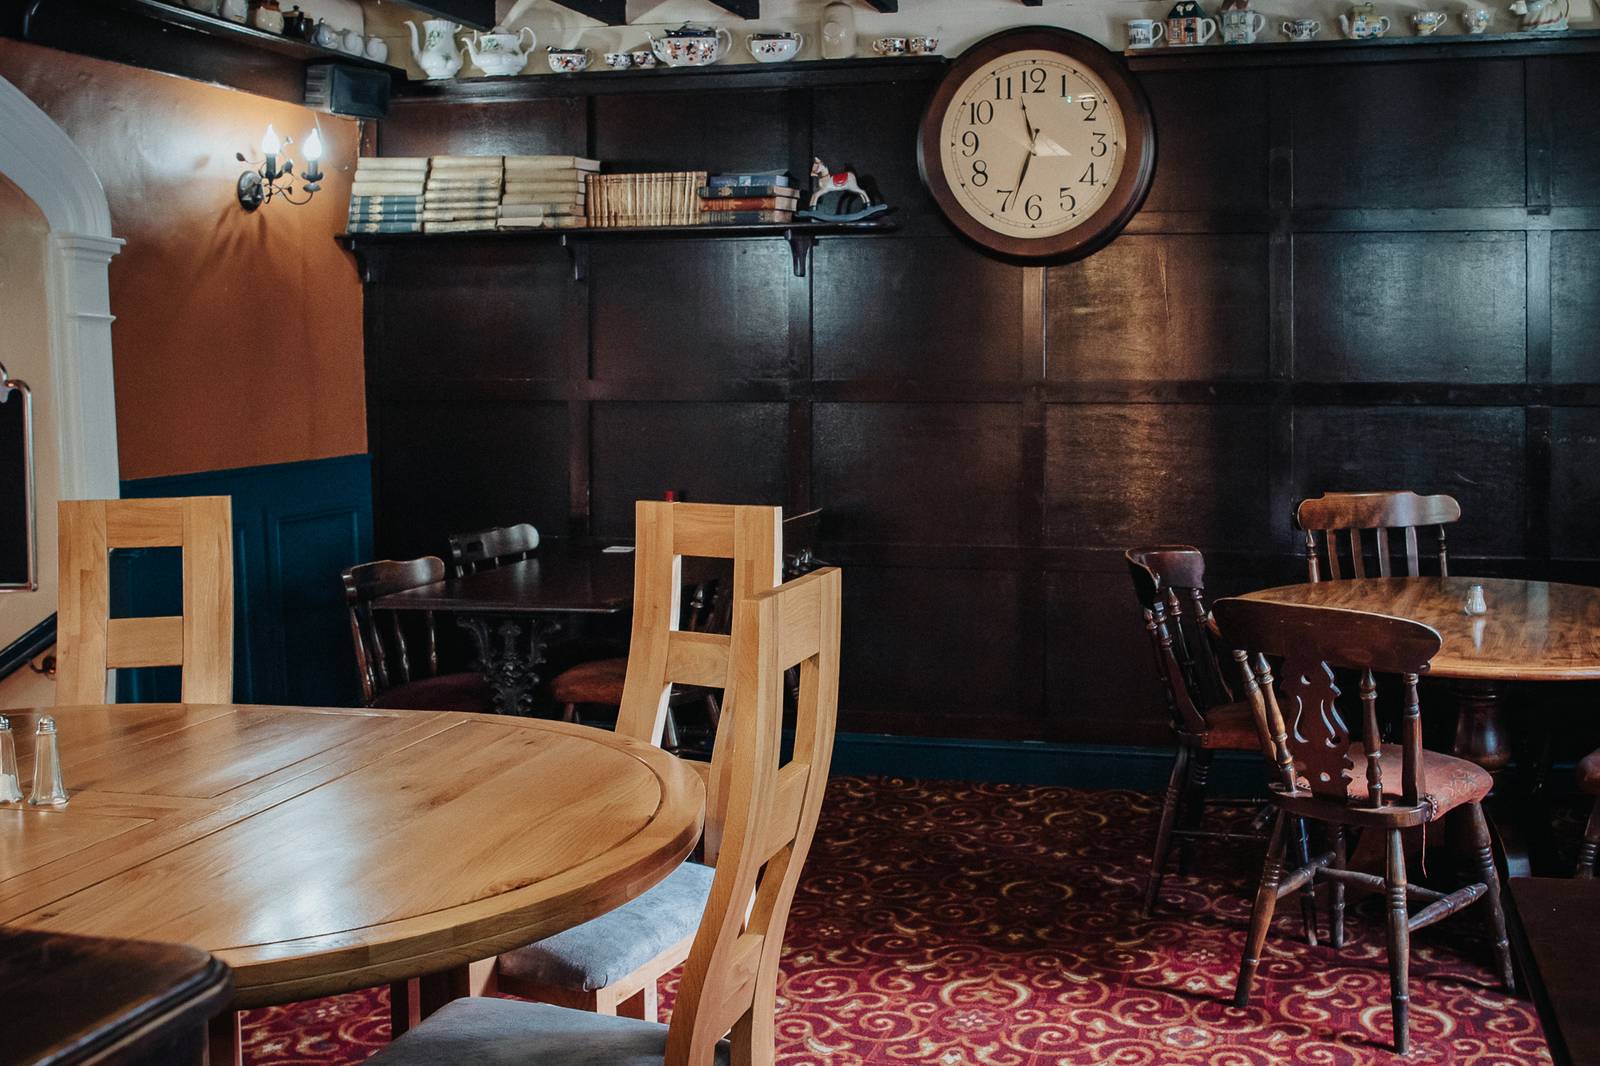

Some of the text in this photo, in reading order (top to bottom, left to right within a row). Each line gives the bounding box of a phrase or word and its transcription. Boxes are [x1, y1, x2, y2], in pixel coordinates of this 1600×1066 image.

[995, 77, 1013, 100] 11
[1020, 68, 1047, 93] 12
[1060, 74, 1067, 97] 1
[970, 100, 994, 125] 10
[1081, 97, 1098, 121] 2
[962, 131, 979, 157] 9
[1090, 132, 1107, 157] 3
[971, 160, 988, 187] 8
[1079, 162, 1099, 185] 4
[996, 189, 1014, 212] 7
[1024, 195, 1043, 221] 6
[1059, 187, 1076, 211] 5
